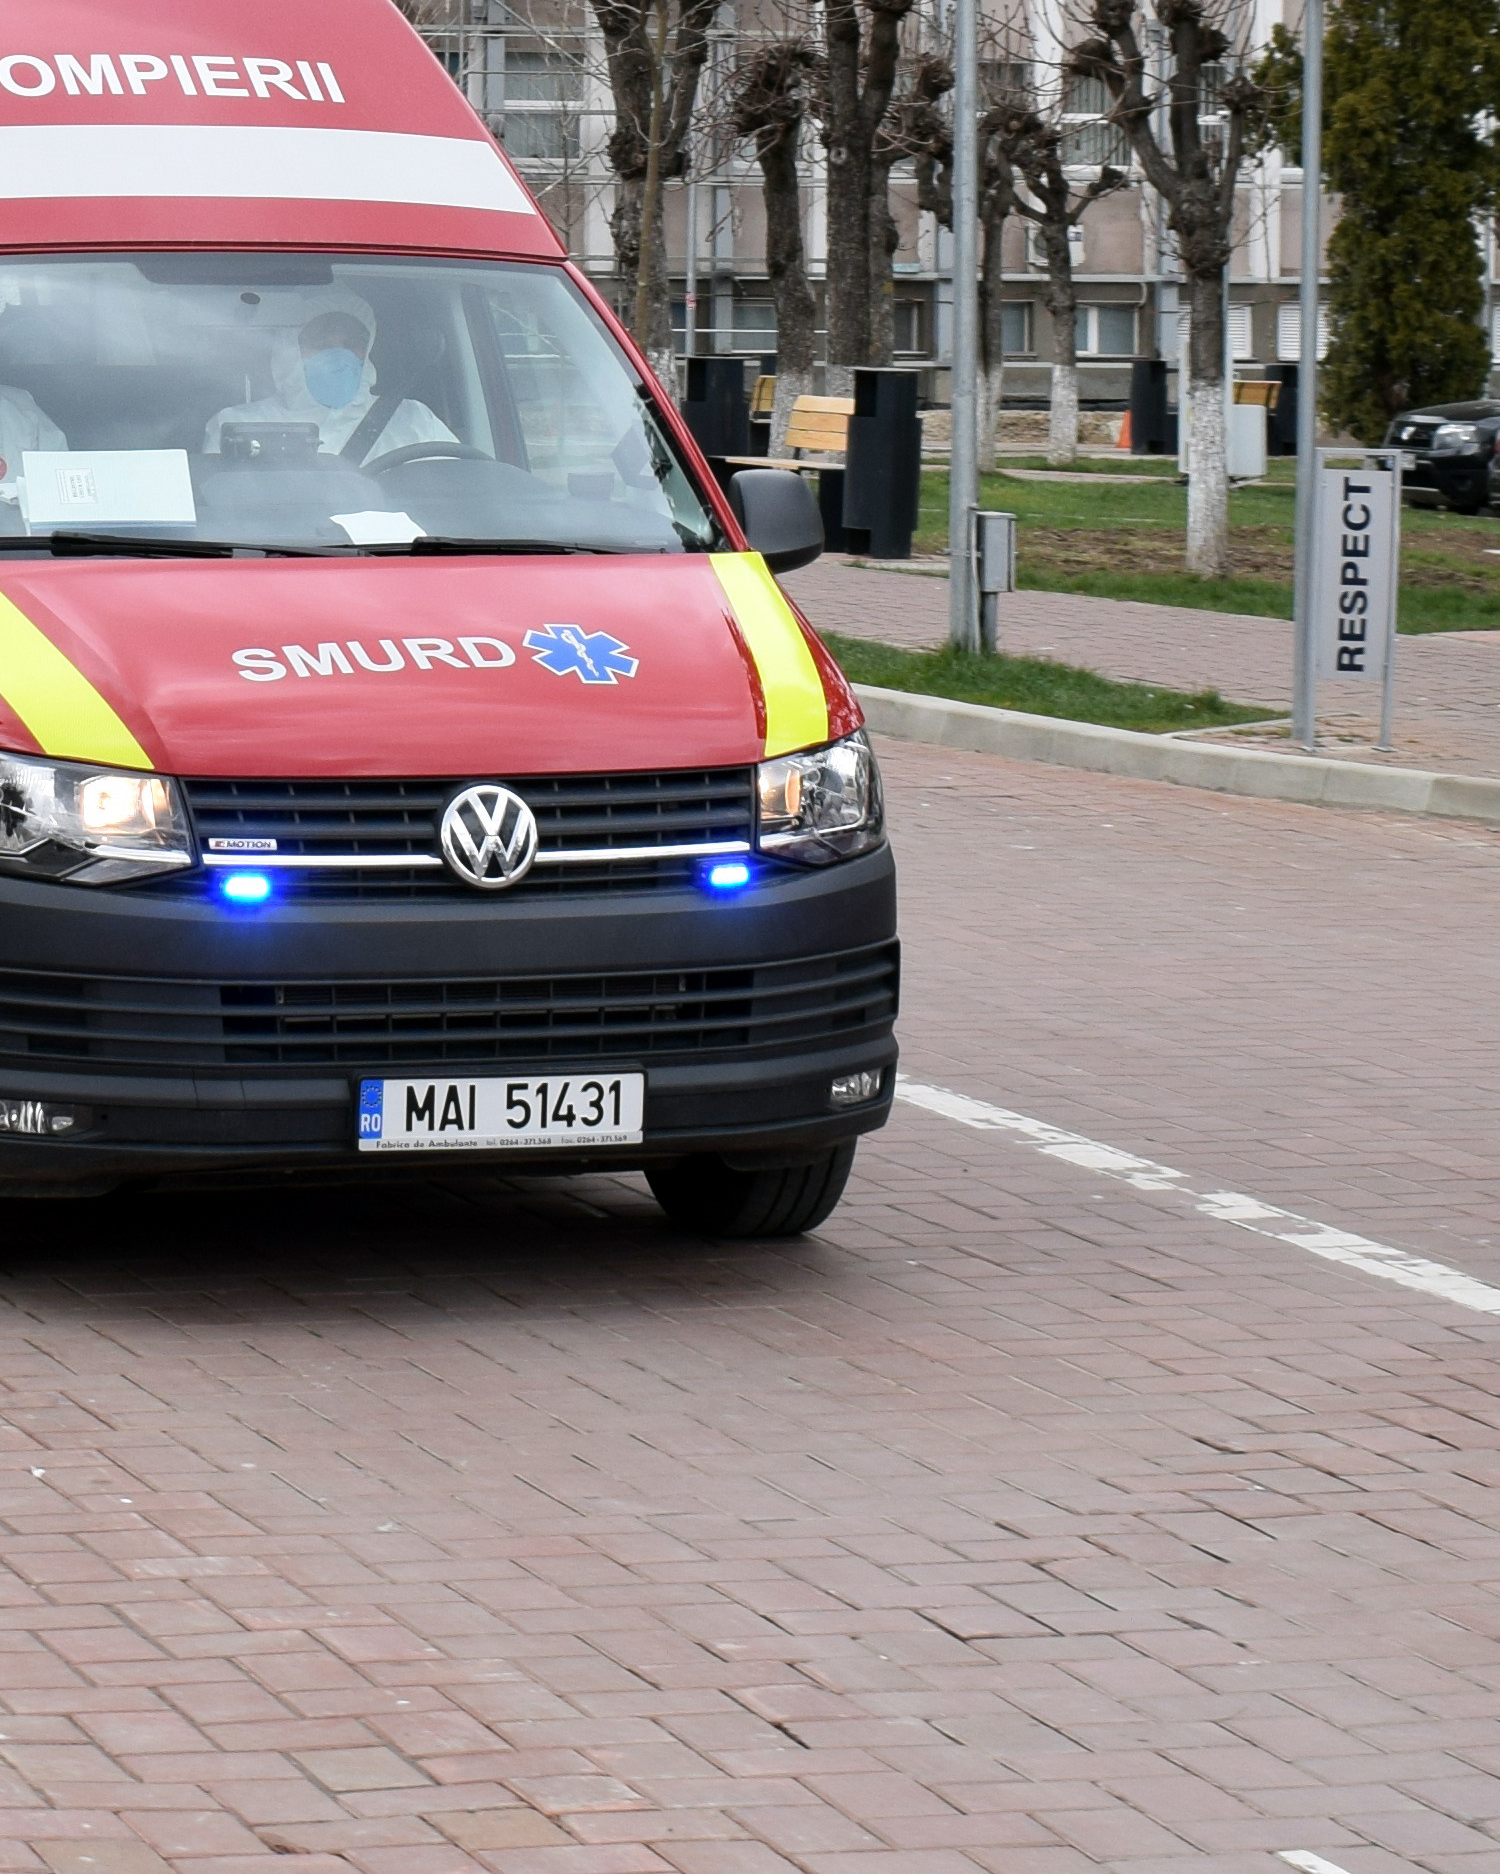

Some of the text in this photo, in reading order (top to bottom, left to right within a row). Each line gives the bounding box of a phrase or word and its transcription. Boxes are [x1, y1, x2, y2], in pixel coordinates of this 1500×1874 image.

[1336, 476, 1372, 672] RESPECT
[231, 636, 516, 682] SMURD
[360, 1113, 381, 1133] RO
[405, 1079, 622, 1132] MAI 51431
